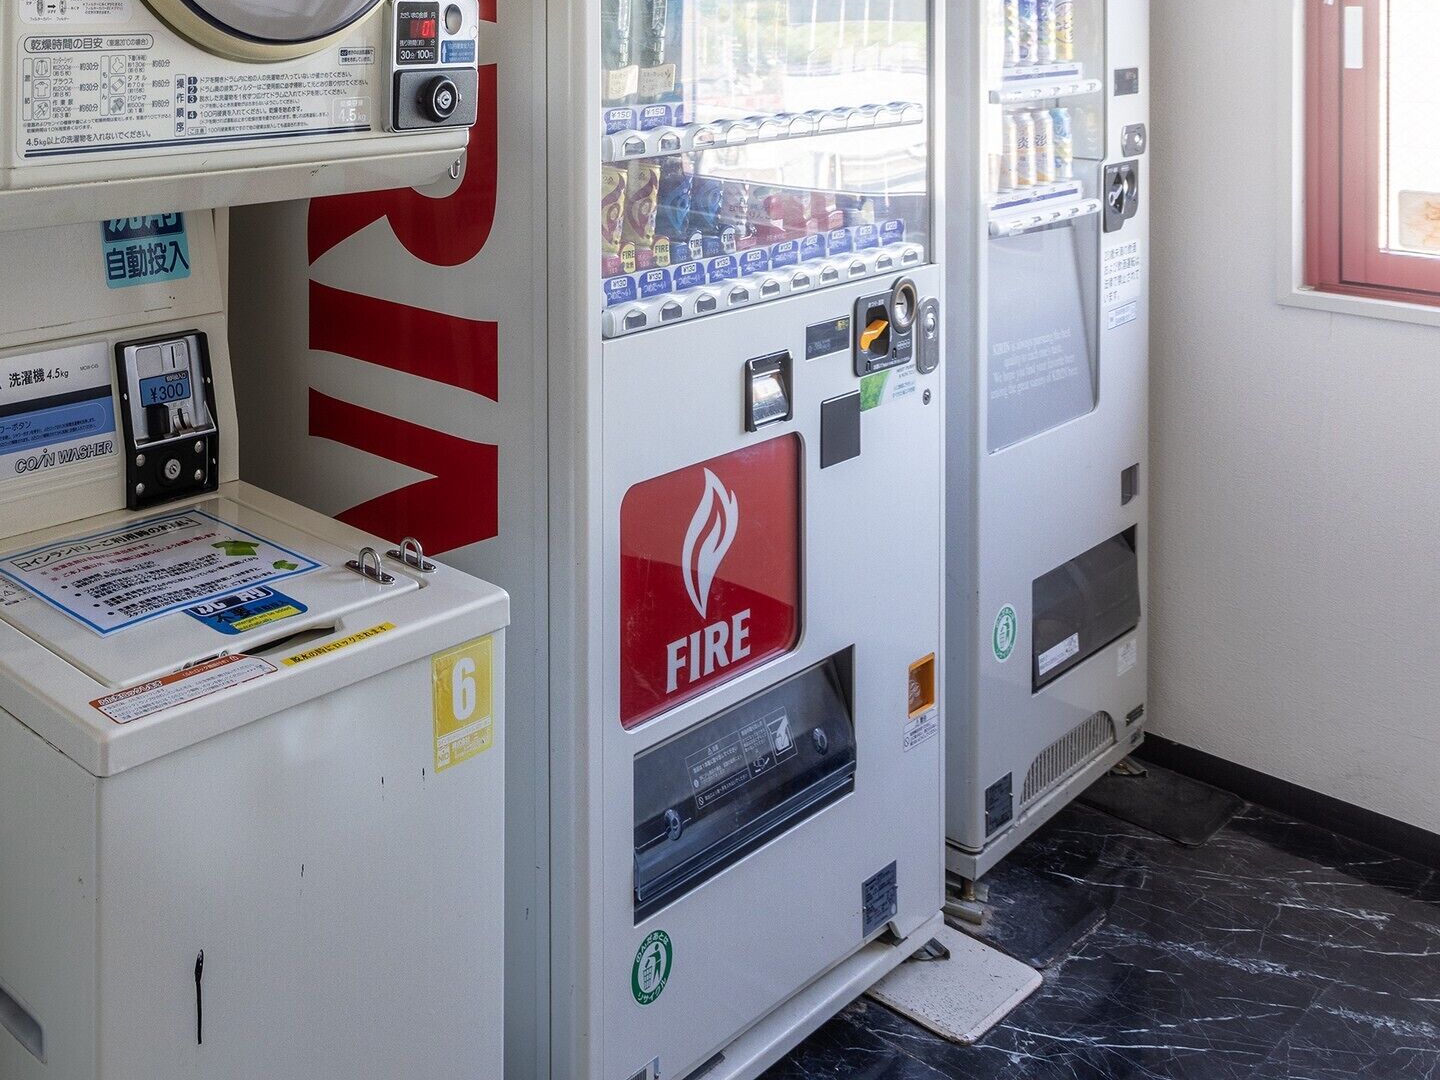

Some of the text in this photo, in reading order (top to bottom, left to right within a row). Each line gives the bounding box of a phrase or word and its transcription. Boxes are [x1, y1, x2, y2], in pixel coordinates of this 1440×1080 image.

[31, 38, 103, 50] 乾燥時間の目安
[107, 241, 189, 280] 自動投入
[655, 244, 669, 253] FIRE
[8, 368, 69, 388] 洗濯機 4.5kg
[150, 382, 184, 402] ¥300
[15, 440, 113, 473] COIN WASHER
[665, 608, 751, 695] FIRE
[453, 658, 476, 721] 6
